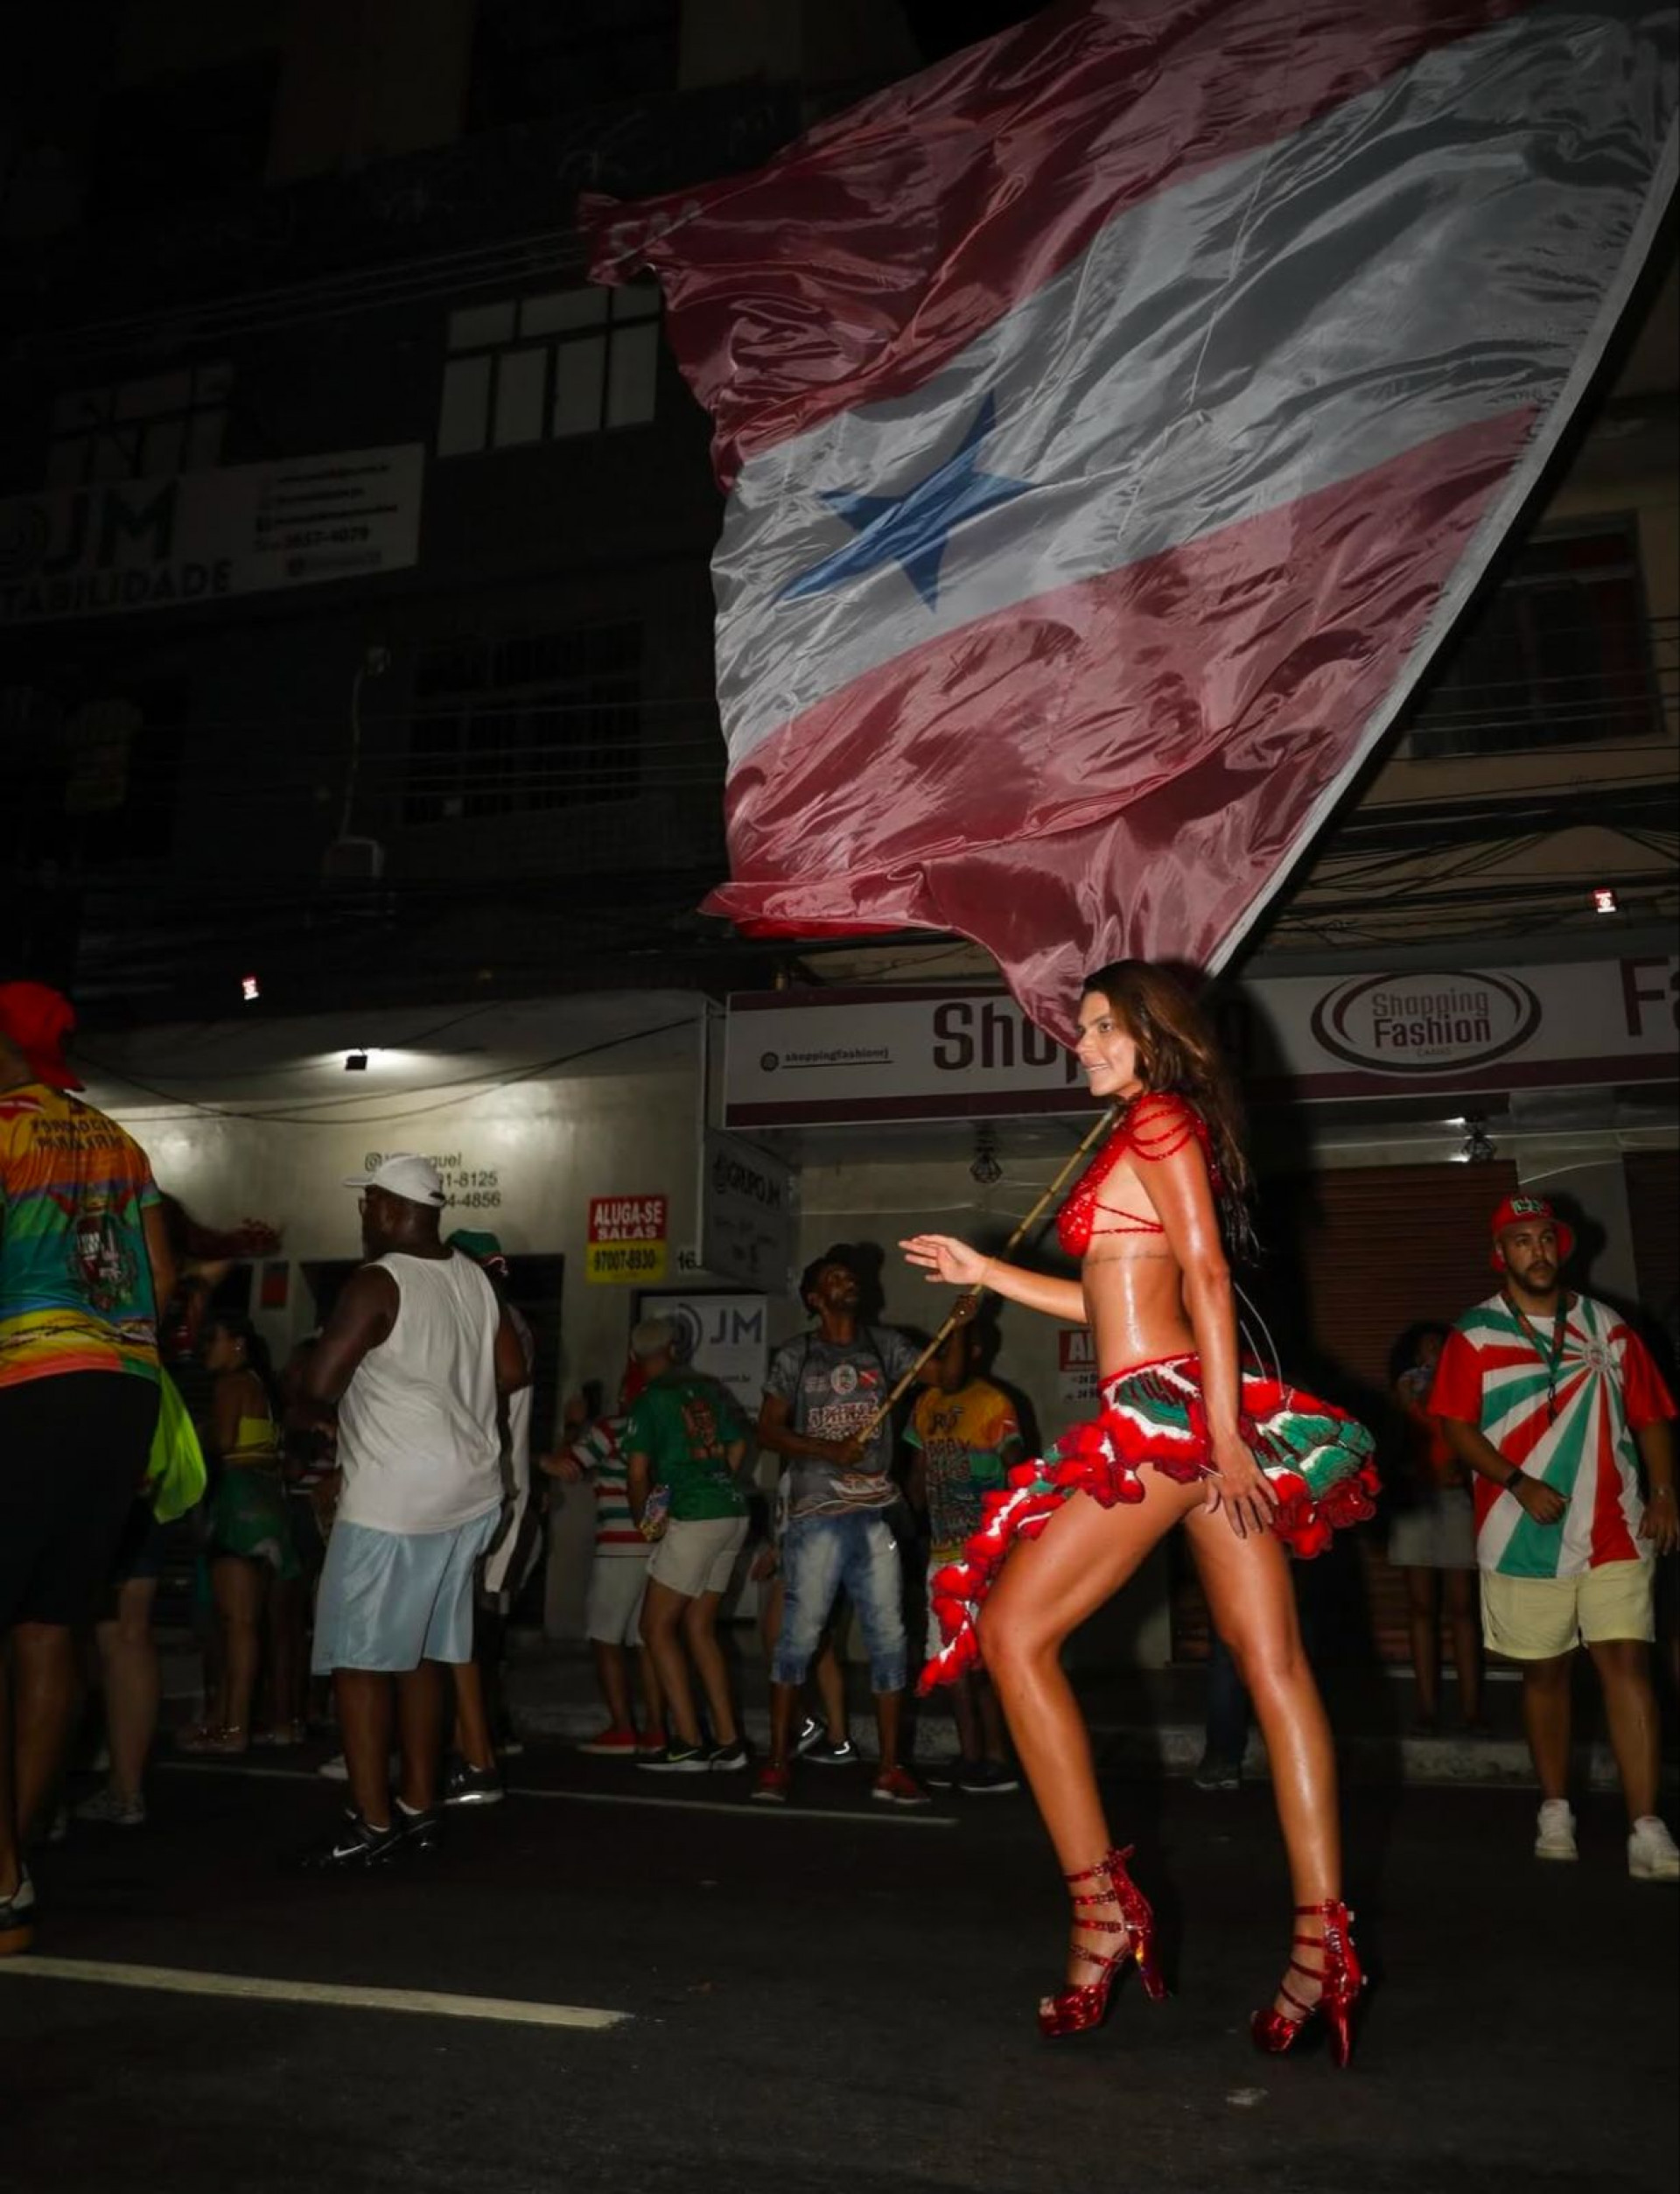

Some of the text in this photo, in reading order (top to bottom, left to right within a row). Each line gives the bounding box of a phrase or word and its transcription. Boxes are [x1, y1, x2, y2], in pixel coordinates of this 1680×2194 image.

[1371, 988, 1488, 1020] Shopping
[1374, 1014, 1491, 1048] Fashion
[593, 1201, 663, 1226] ALUGA-SE
[597, 1224, 657, 1241] SALAS
[710, 1309, 762, 1345] JM
